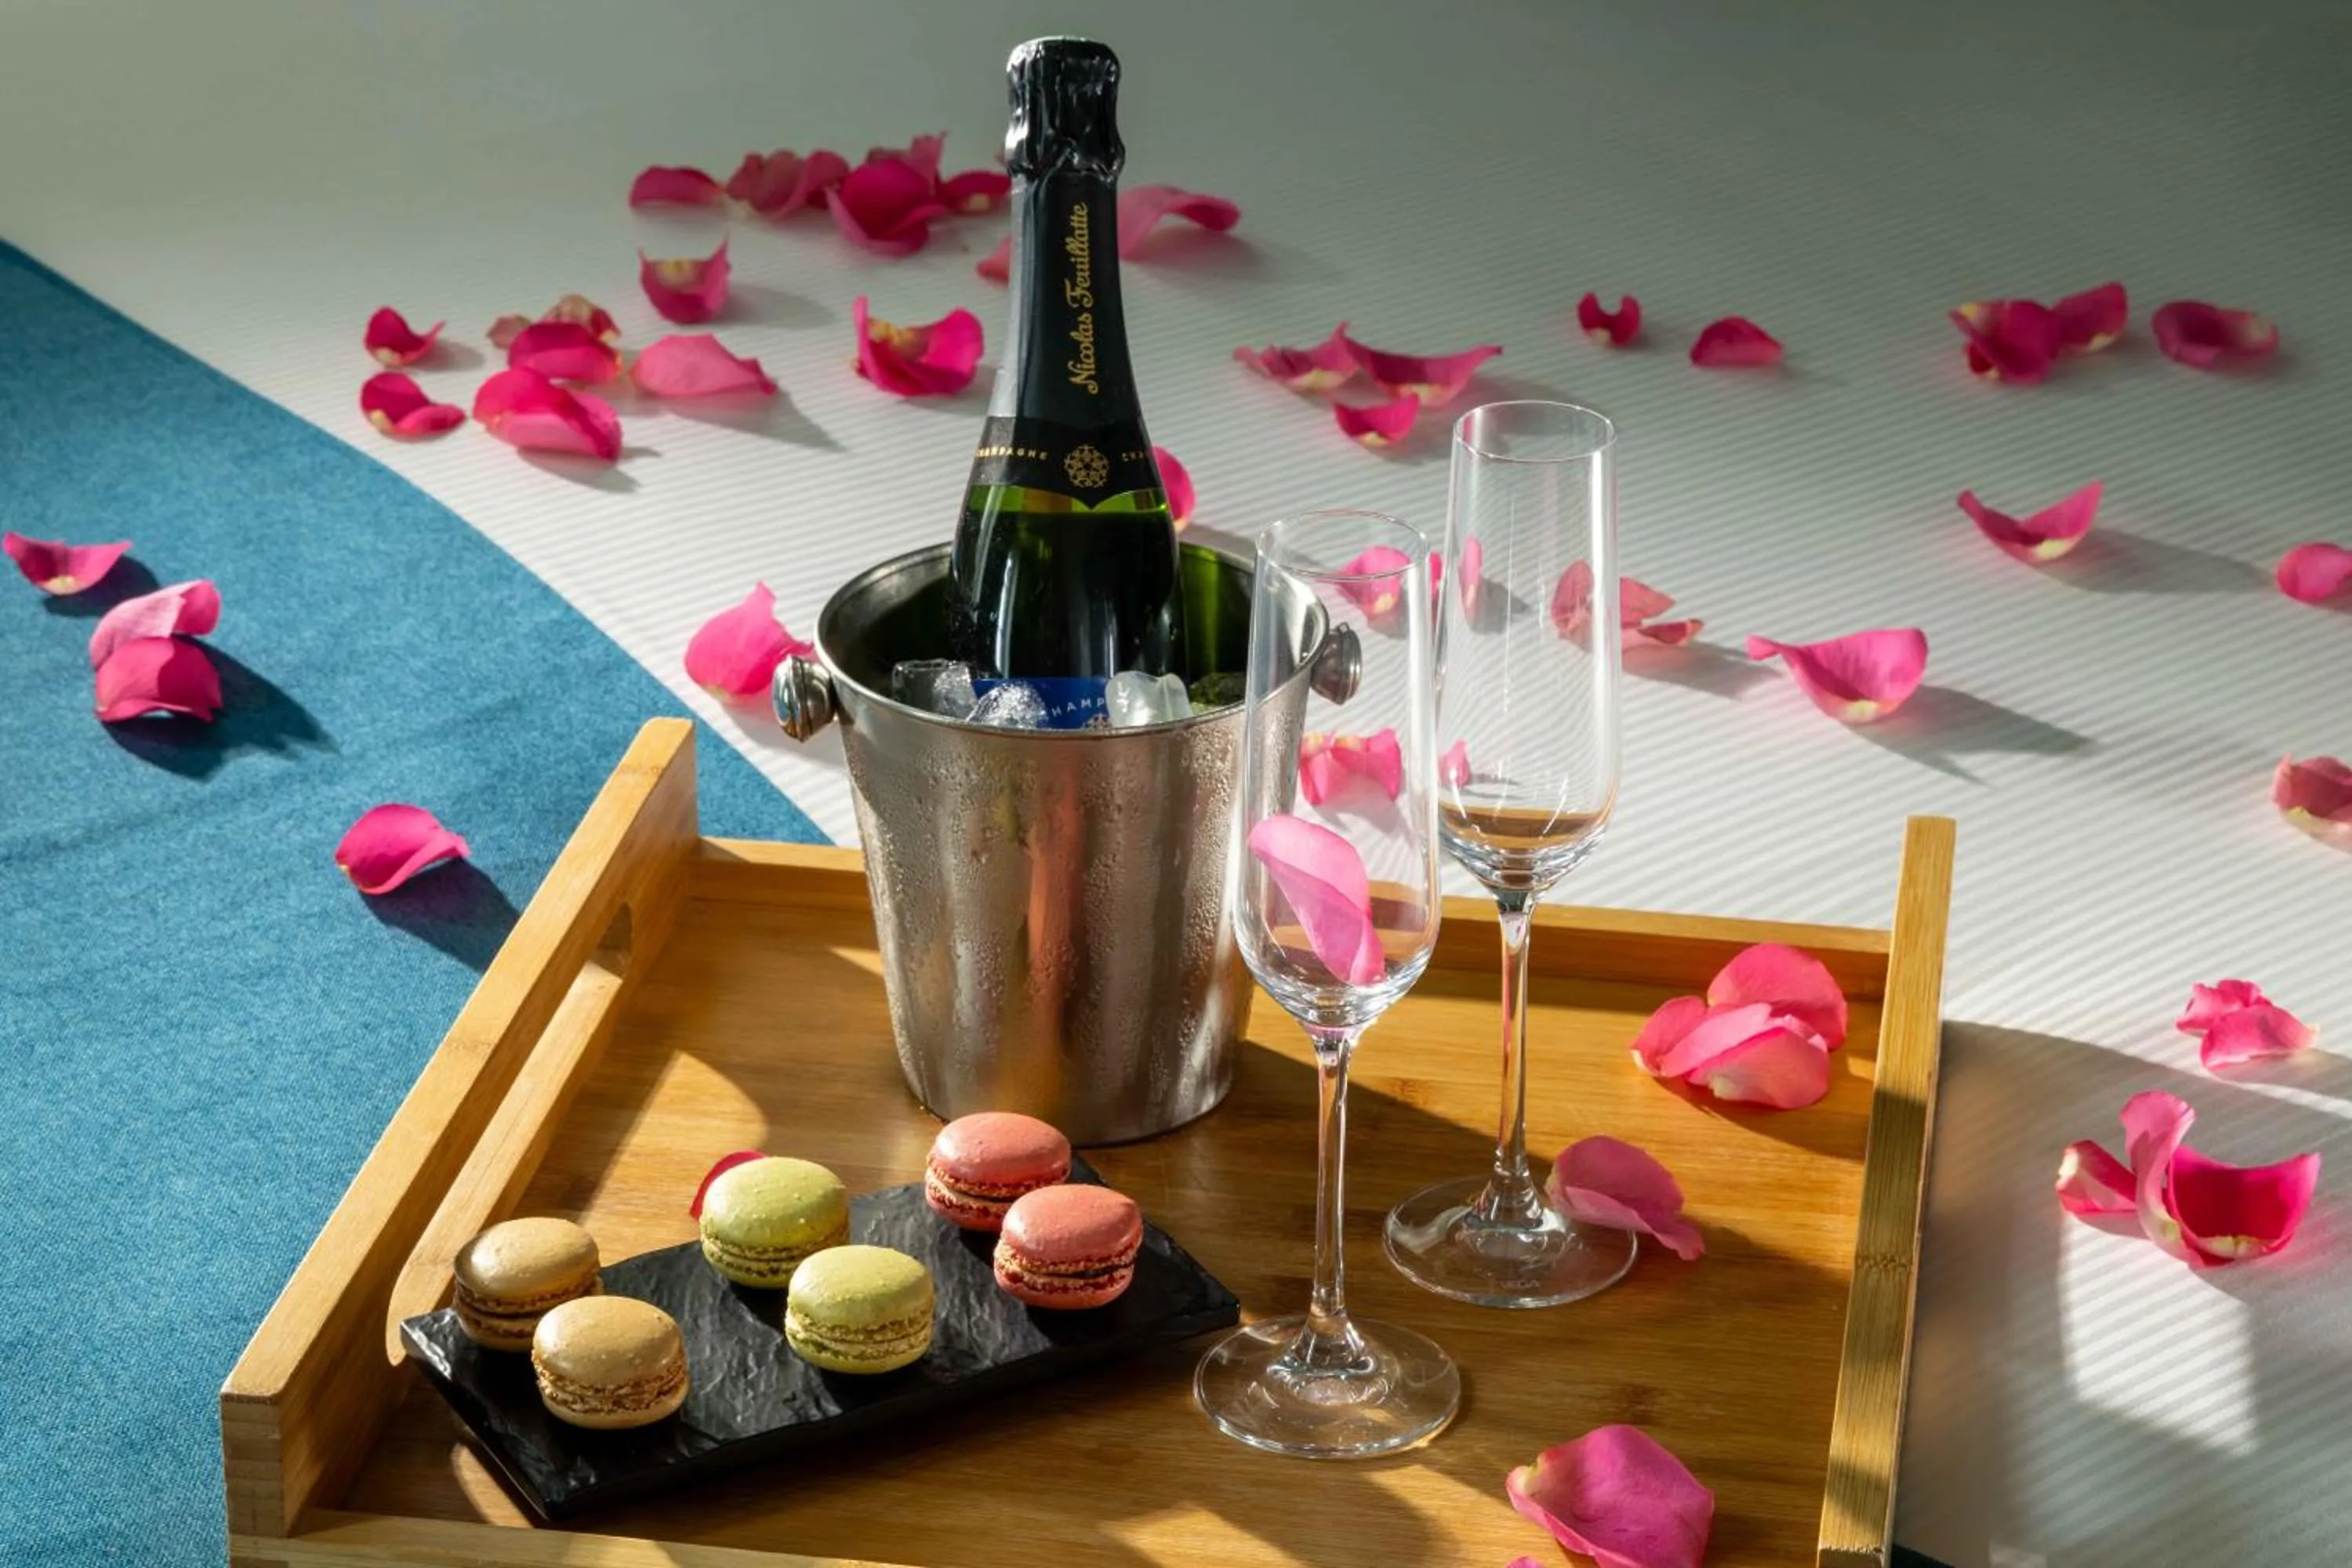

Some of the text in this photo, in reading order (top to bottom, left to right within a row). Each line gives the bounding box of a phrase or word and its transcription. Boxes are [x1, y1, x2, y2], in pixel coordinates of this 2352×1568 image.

[1064, 201, 1098, 394] Nicolas Feuillatte
[1051, 697, 1105, 717] HAMP
